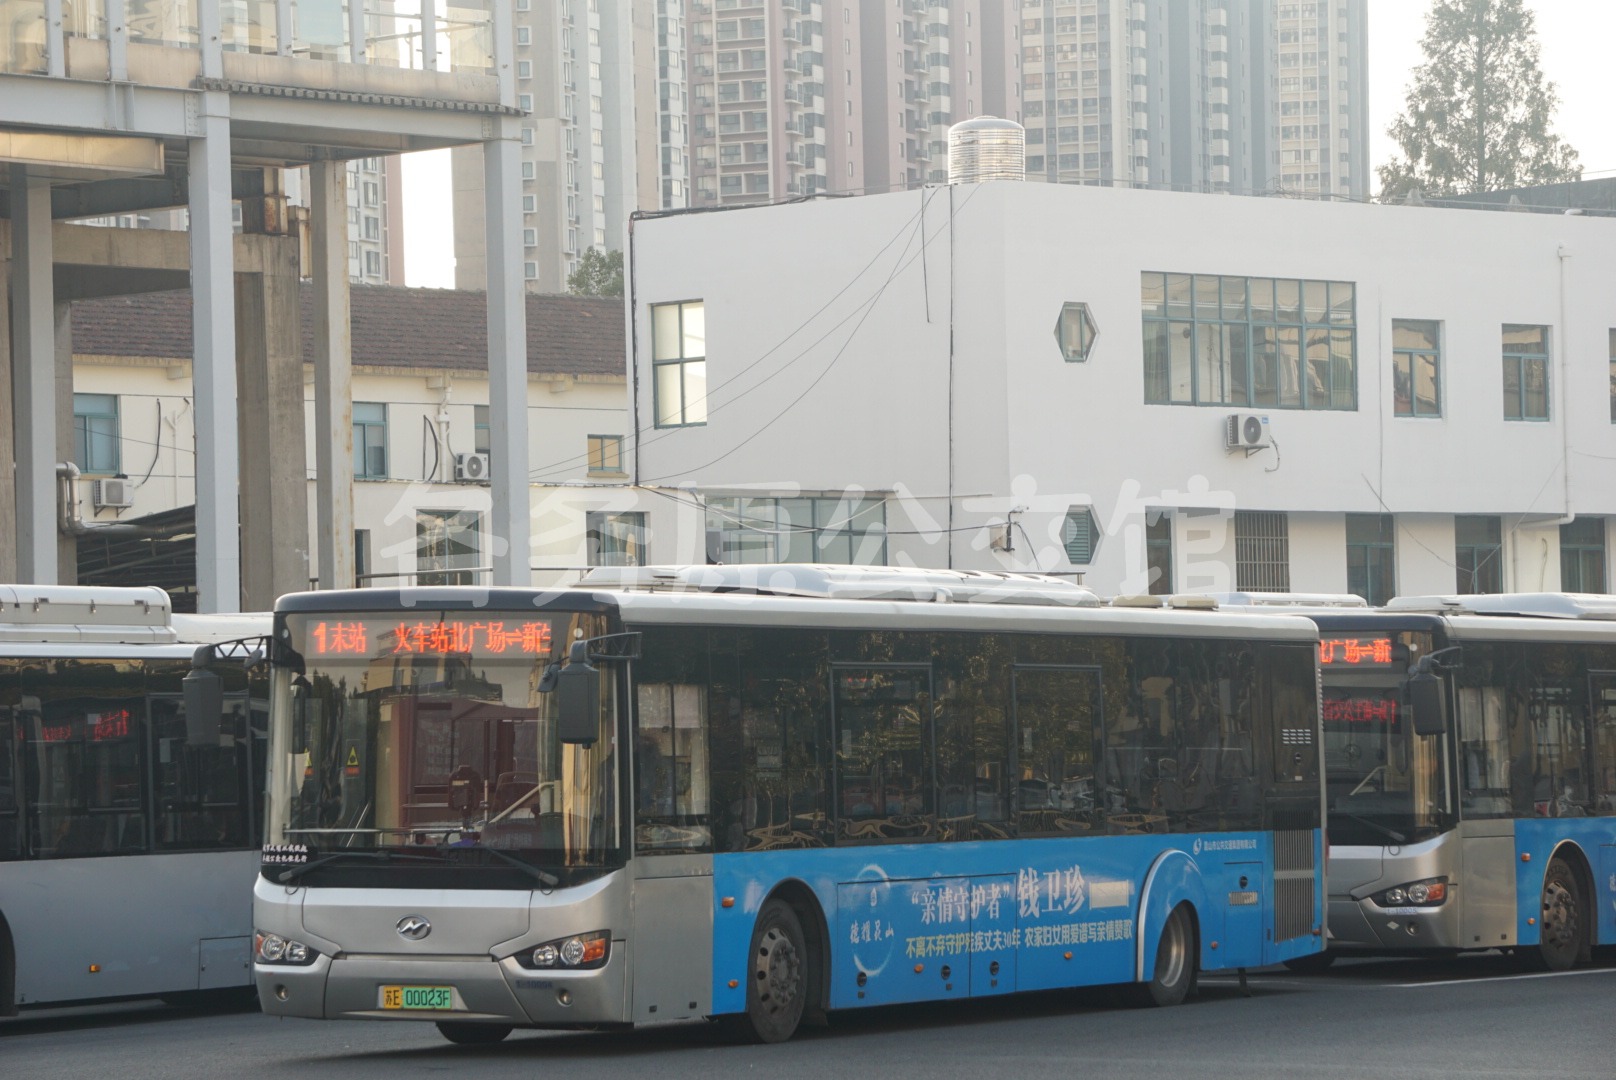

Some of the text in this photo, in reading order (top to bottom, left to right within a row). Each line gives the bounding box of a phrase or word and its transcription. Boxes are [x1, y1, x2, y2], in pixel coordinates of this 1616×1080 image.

[1018, 864, 1086, 919] 钱卫珍
[905, 919, 1133, 959] 不离不弃守护残疾丈夫30年 农家妇女用爱谱写亲情赞歌
